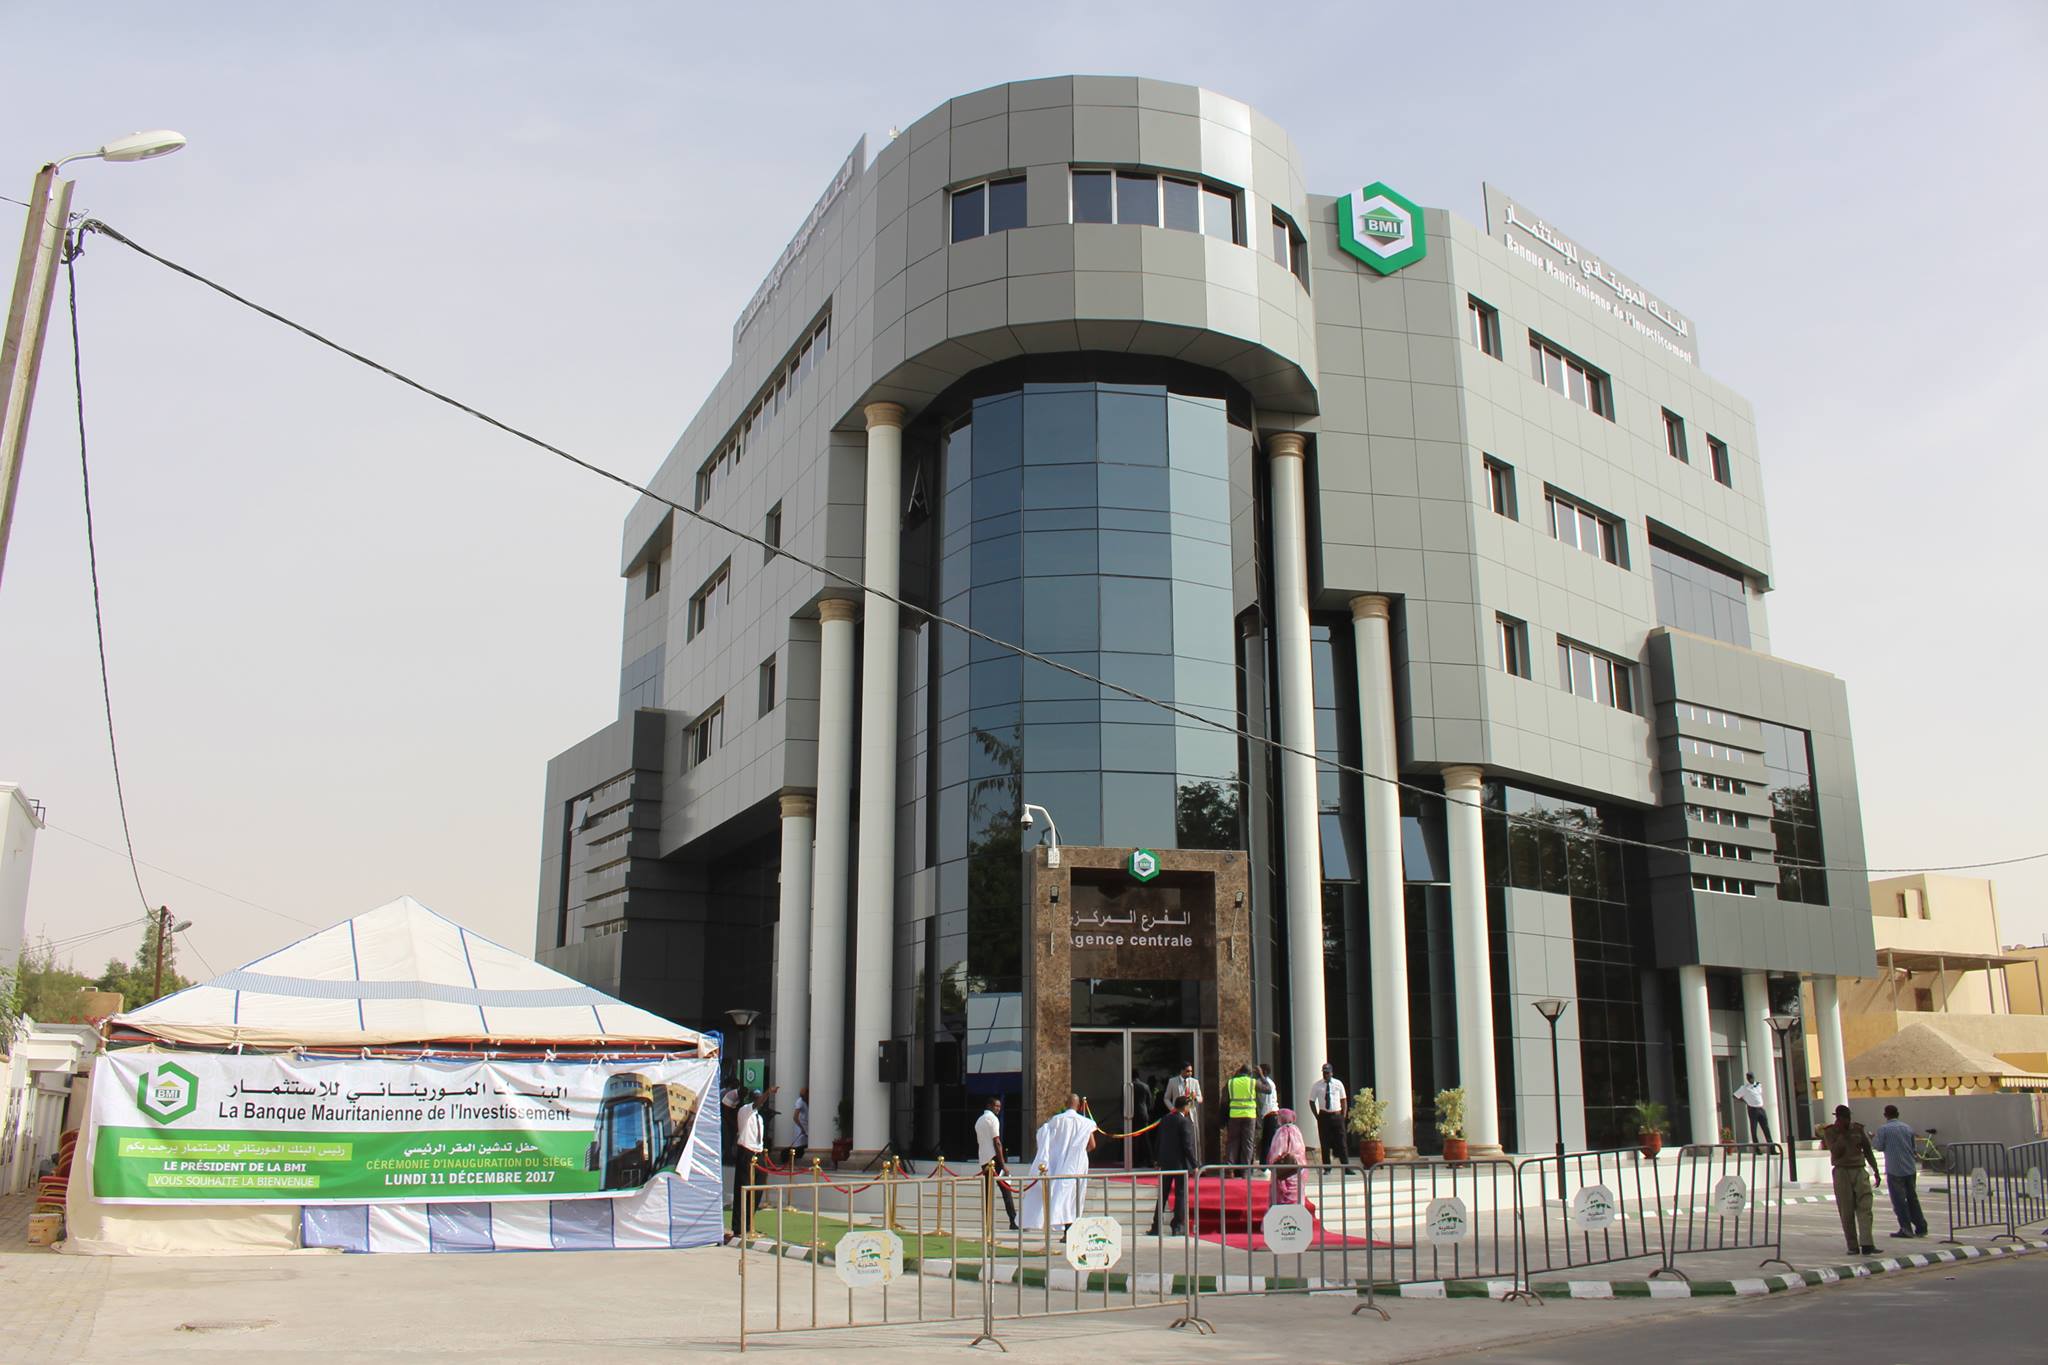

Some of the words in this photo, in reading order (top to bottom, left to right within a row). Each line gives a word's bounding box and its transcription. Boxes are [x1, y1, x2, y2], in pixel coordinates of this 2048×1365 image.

[1368, 219, 1398, 233] BMI
[1544, 258, 1611, 313] Mauritanienne
[1612, 303, 1625, 320] de
[1070, 909, 1136, 927] المركز
[1141, 909, 1191, 932] الفرع
[1130, 934, 1193, 947] centrale
[158, 1089, 178, 1098] BMI
[346, 1081, 486, 1103] الموريتاني
[219, 1102, 238, 1118] La
[244, 1103, 306, 1123] Banque
[311, 1104, 423, 1121] Mauritanienne
[427, 1105, 445, 1120] de
[451, 1103, 570, 1121] l'Investissement
[126, 1142, 145, 1153] بكم
[234, 1144, 285, 1158] الموريتاني
[288, 1145, 316, 1154] البنك
[404, 1144, 446, 1157] الرئيسي
[449, 1143, 476, 1155] المقر
[478, 1142, 513, 1155] تدشين
[515, 1143, 539, 1154] حفل
[164, 1161, 178, 1171] LE
[181, 1159, 247, 1171] PRÉSIDENT
[249, 1162, 264, 1172] DE
[267, 1162, 281, 1172] LA
[284, 1163, 306, 1172] BMI
[366, 1158, 430, 1170] CÉRÉMONIE
[433, 1157, 522, 1169] D'INAUGURATION
[525, 1158, 541, 1168] DU
[543, 1155, 574, 1168] SIÈGE
[154, 1175, 183, 1185] VOUS
[186, 1176, 239, 1186] SOUHAITE
[241, 1177, 254, 1186] LA
[257, 1177, 315, 1187] BIENVENUE
[385, 1173, 427, 1186] LUNDI
[430, 1173, 444, 1185] 11
[449, 1169, 521, 1184] DÉCEMBRE
[525, 1171, 555, 1183] 2017
